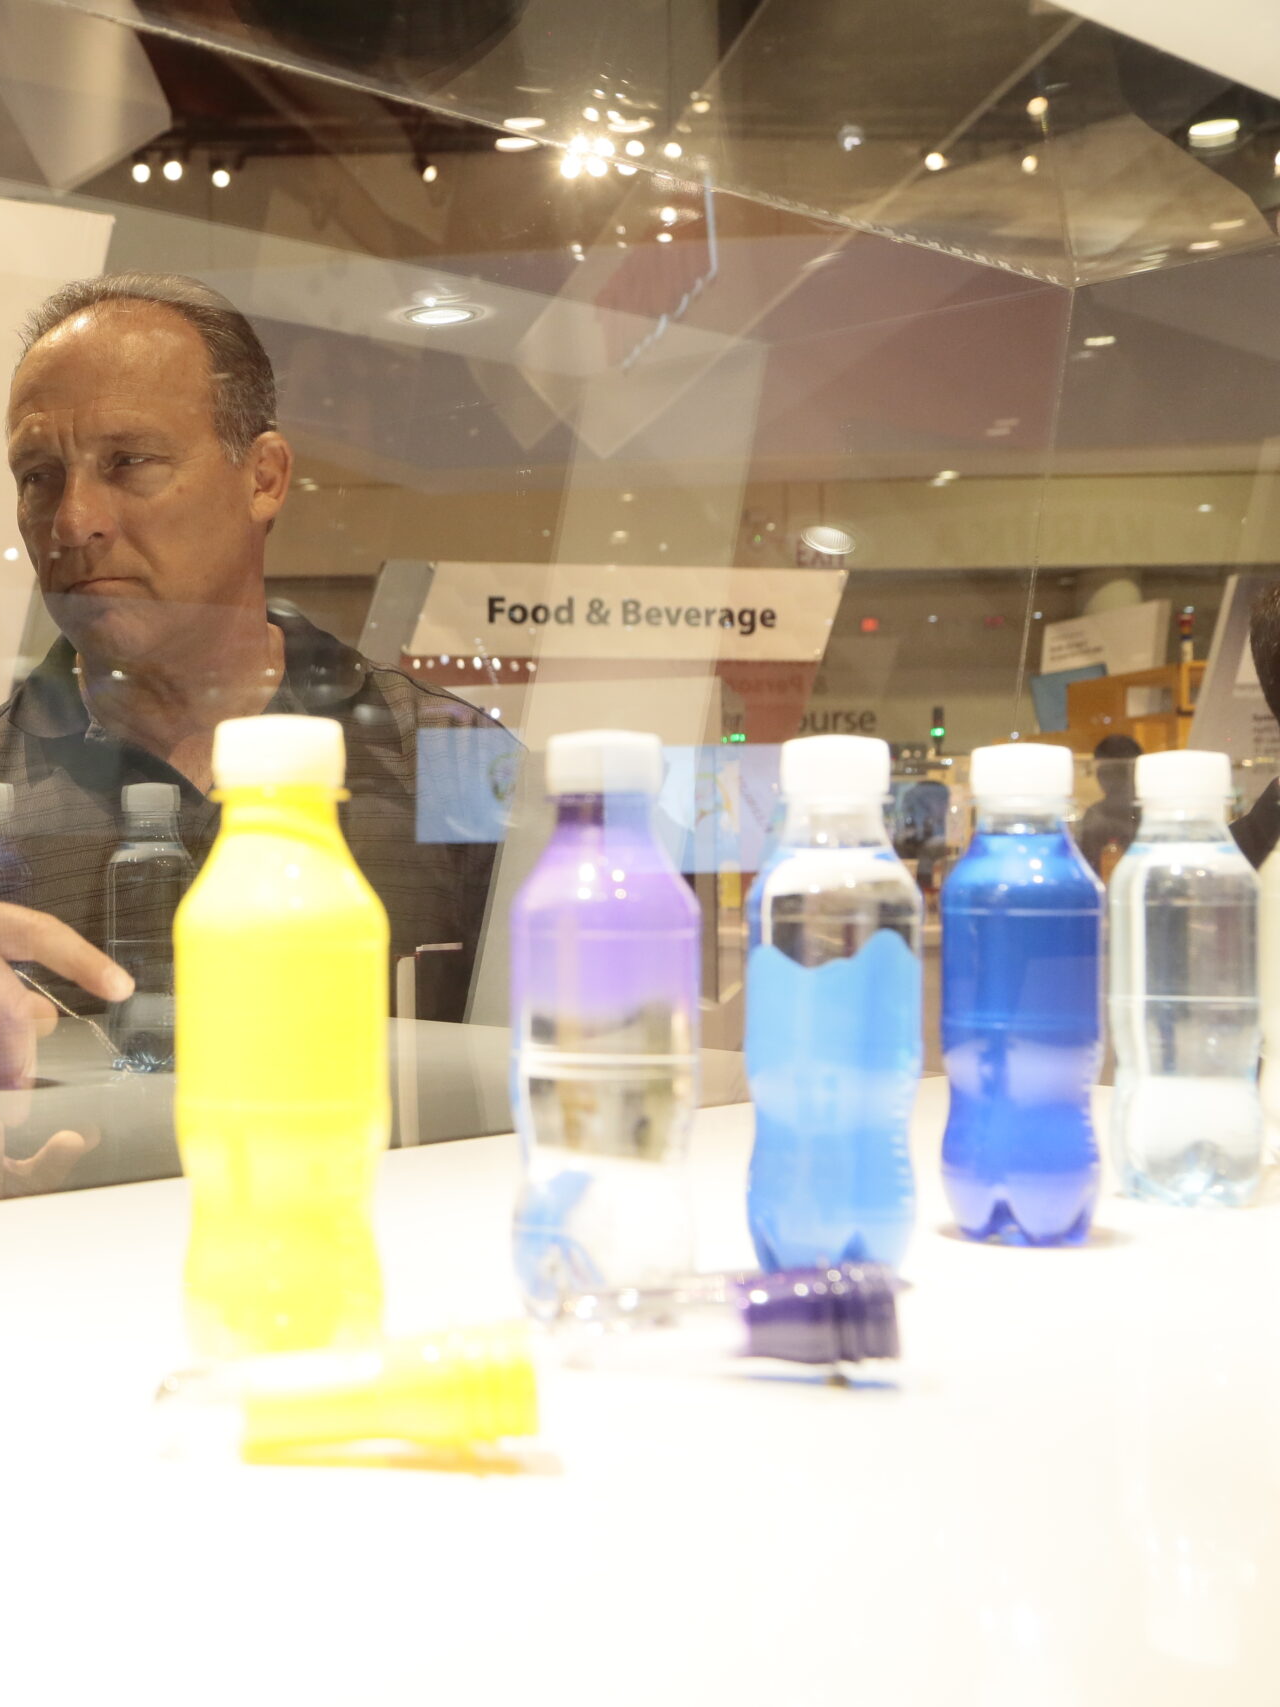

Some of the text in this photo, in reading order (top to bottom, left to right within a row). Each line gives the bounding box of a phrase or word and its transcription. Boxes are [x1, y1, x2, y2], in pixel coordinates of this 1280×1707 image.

[487, 596, 777, 636] Food & Beverage
